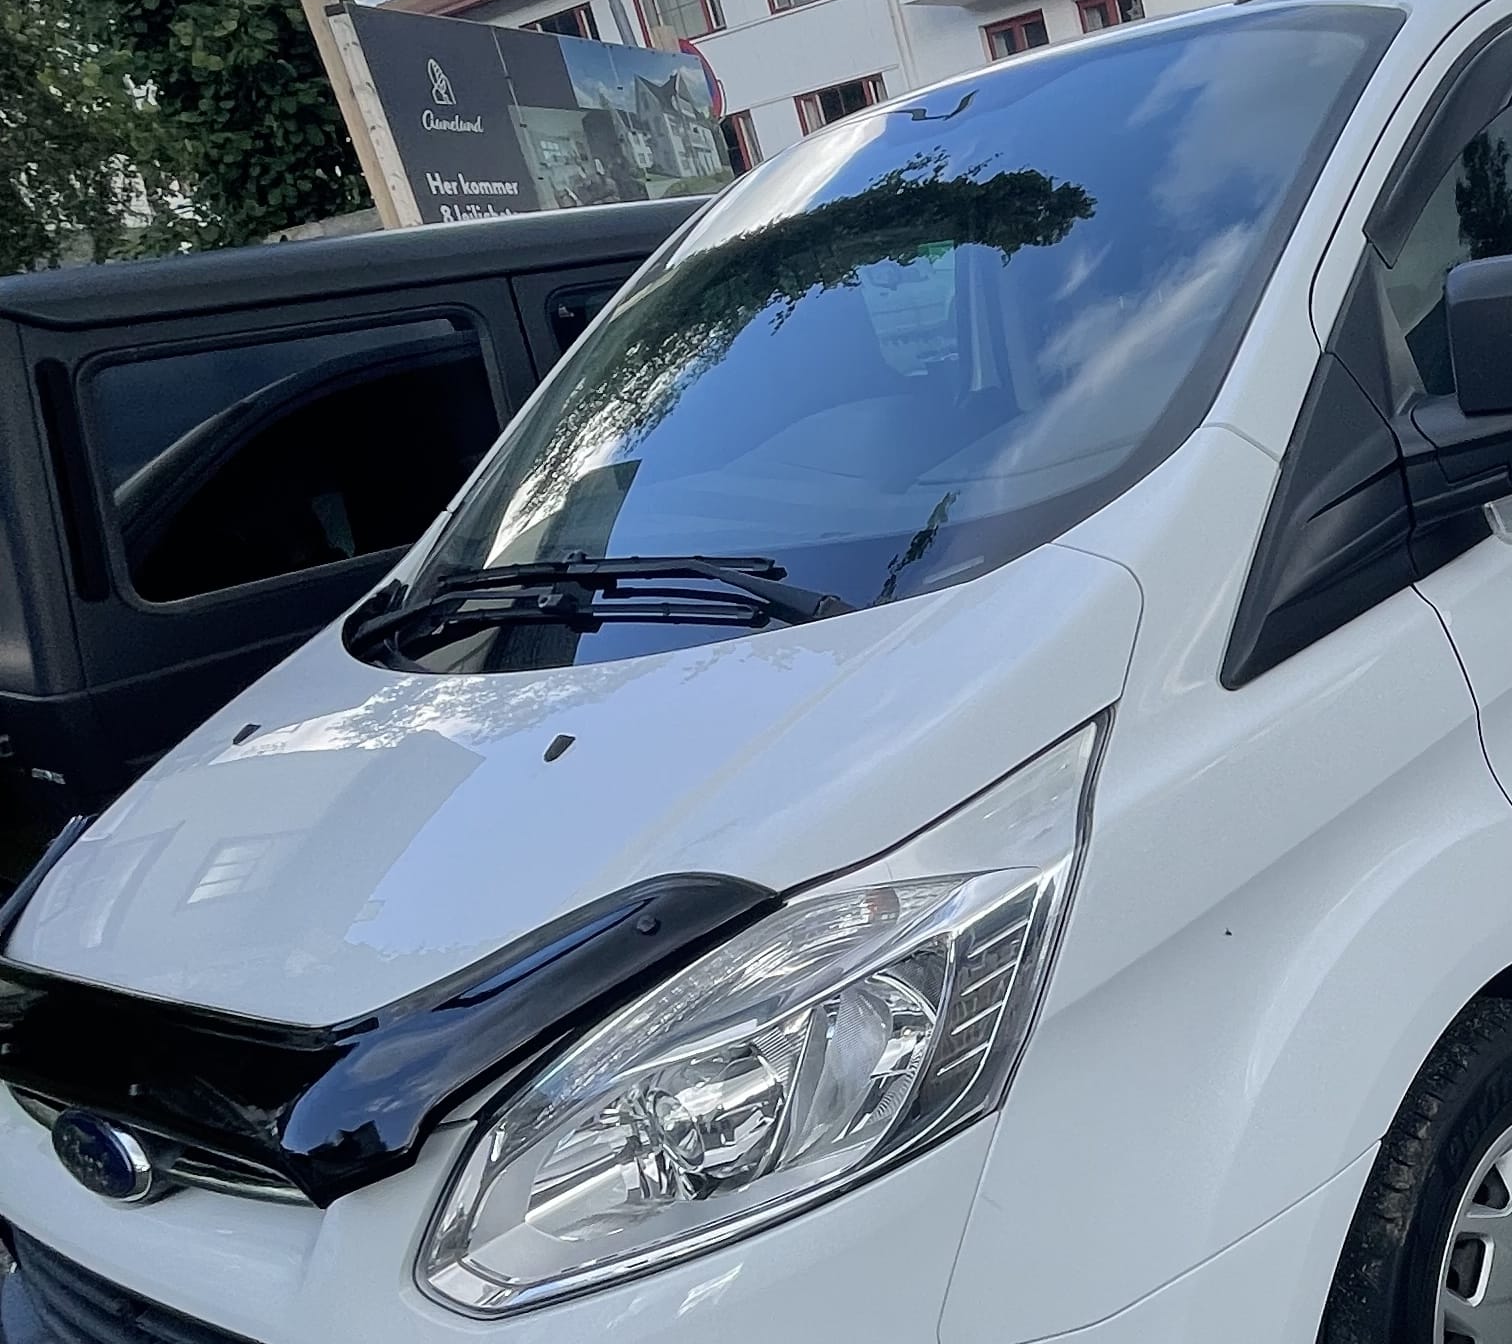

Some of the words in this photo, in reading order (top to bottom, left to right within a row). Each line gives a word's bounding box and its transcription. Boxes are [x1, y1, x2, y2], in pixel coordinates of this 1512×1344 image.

[426, 172, 459, 195] Her
[458, 173, 519, 195] kommer
[440, 205, 455, 223] 8
